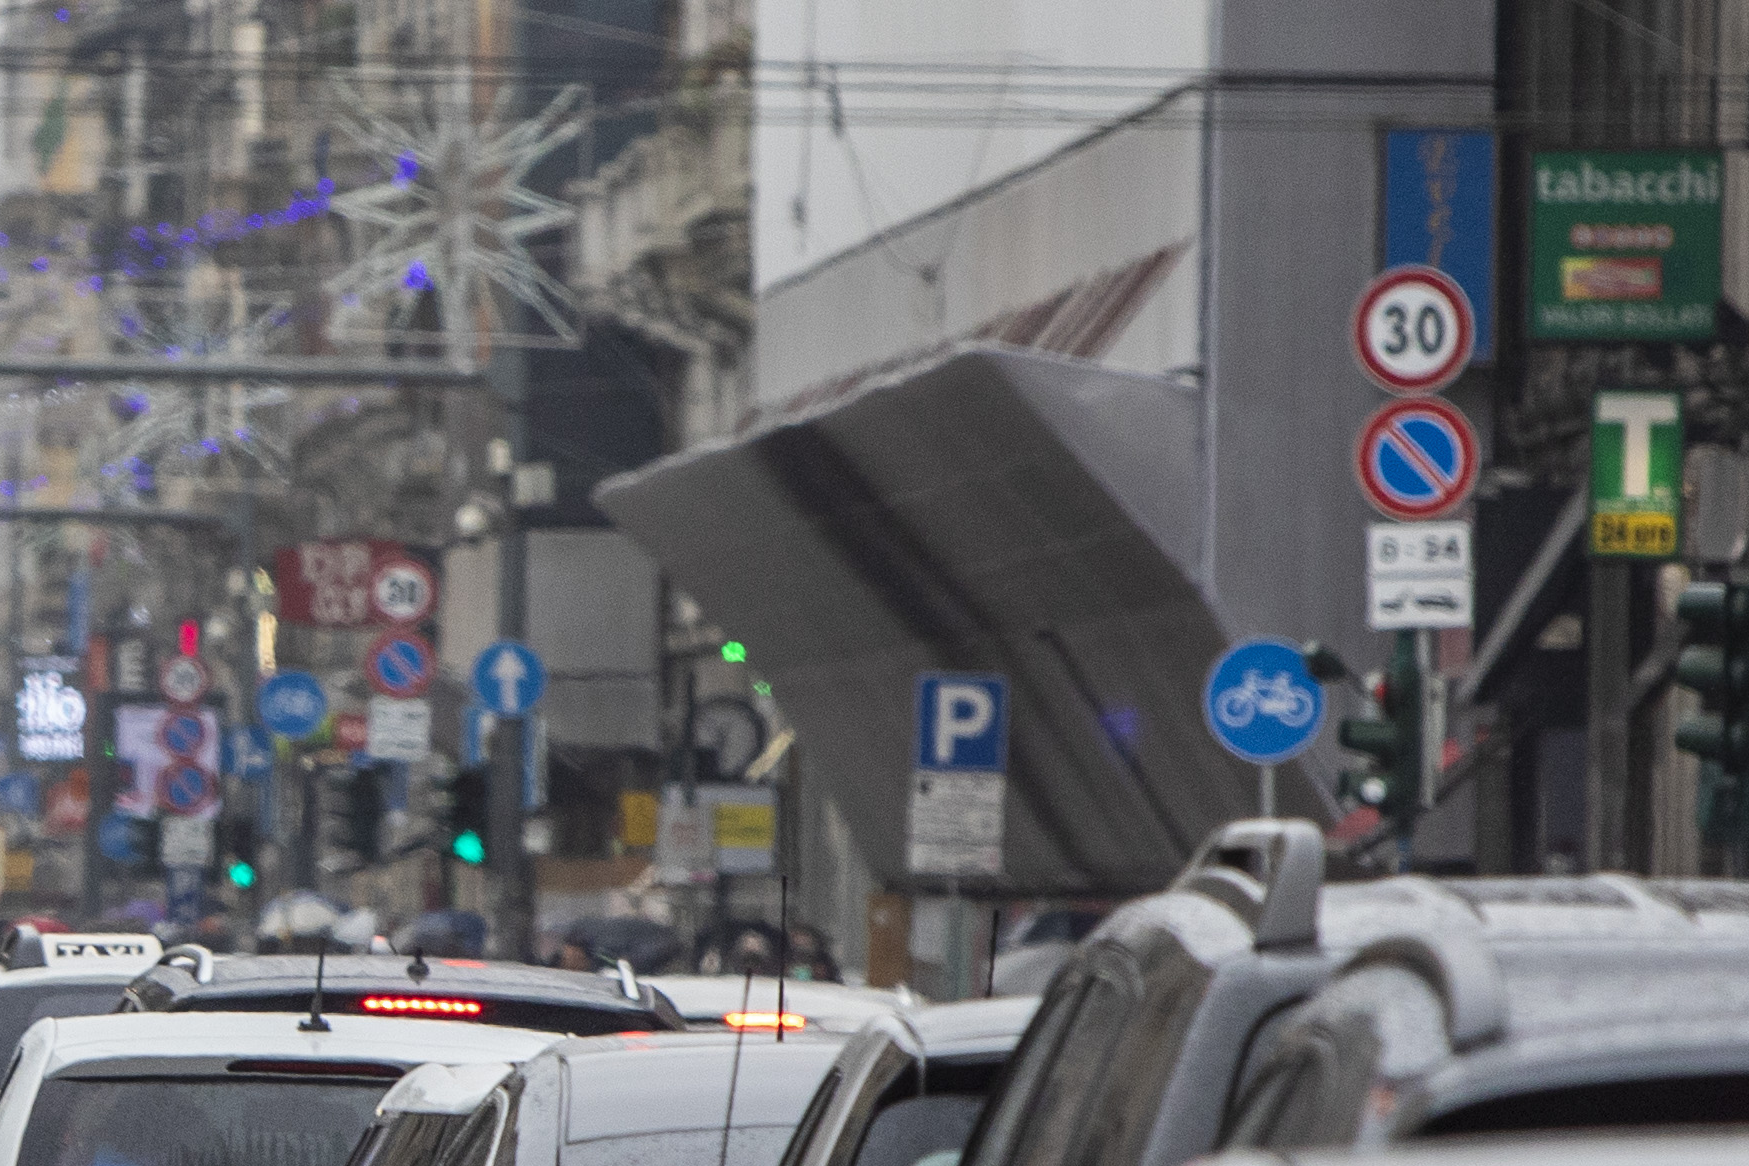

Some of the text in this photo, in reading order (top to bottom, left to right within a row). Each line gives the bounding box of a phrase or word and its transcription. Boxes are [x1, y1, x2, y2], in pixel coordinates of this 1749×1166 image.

[1536, 161, 1720, 204] tabacchi
[1383, 304, 1446, 356] 30
[1596, 393, 1680, 498] T
[934, 682, 996, 764] P
